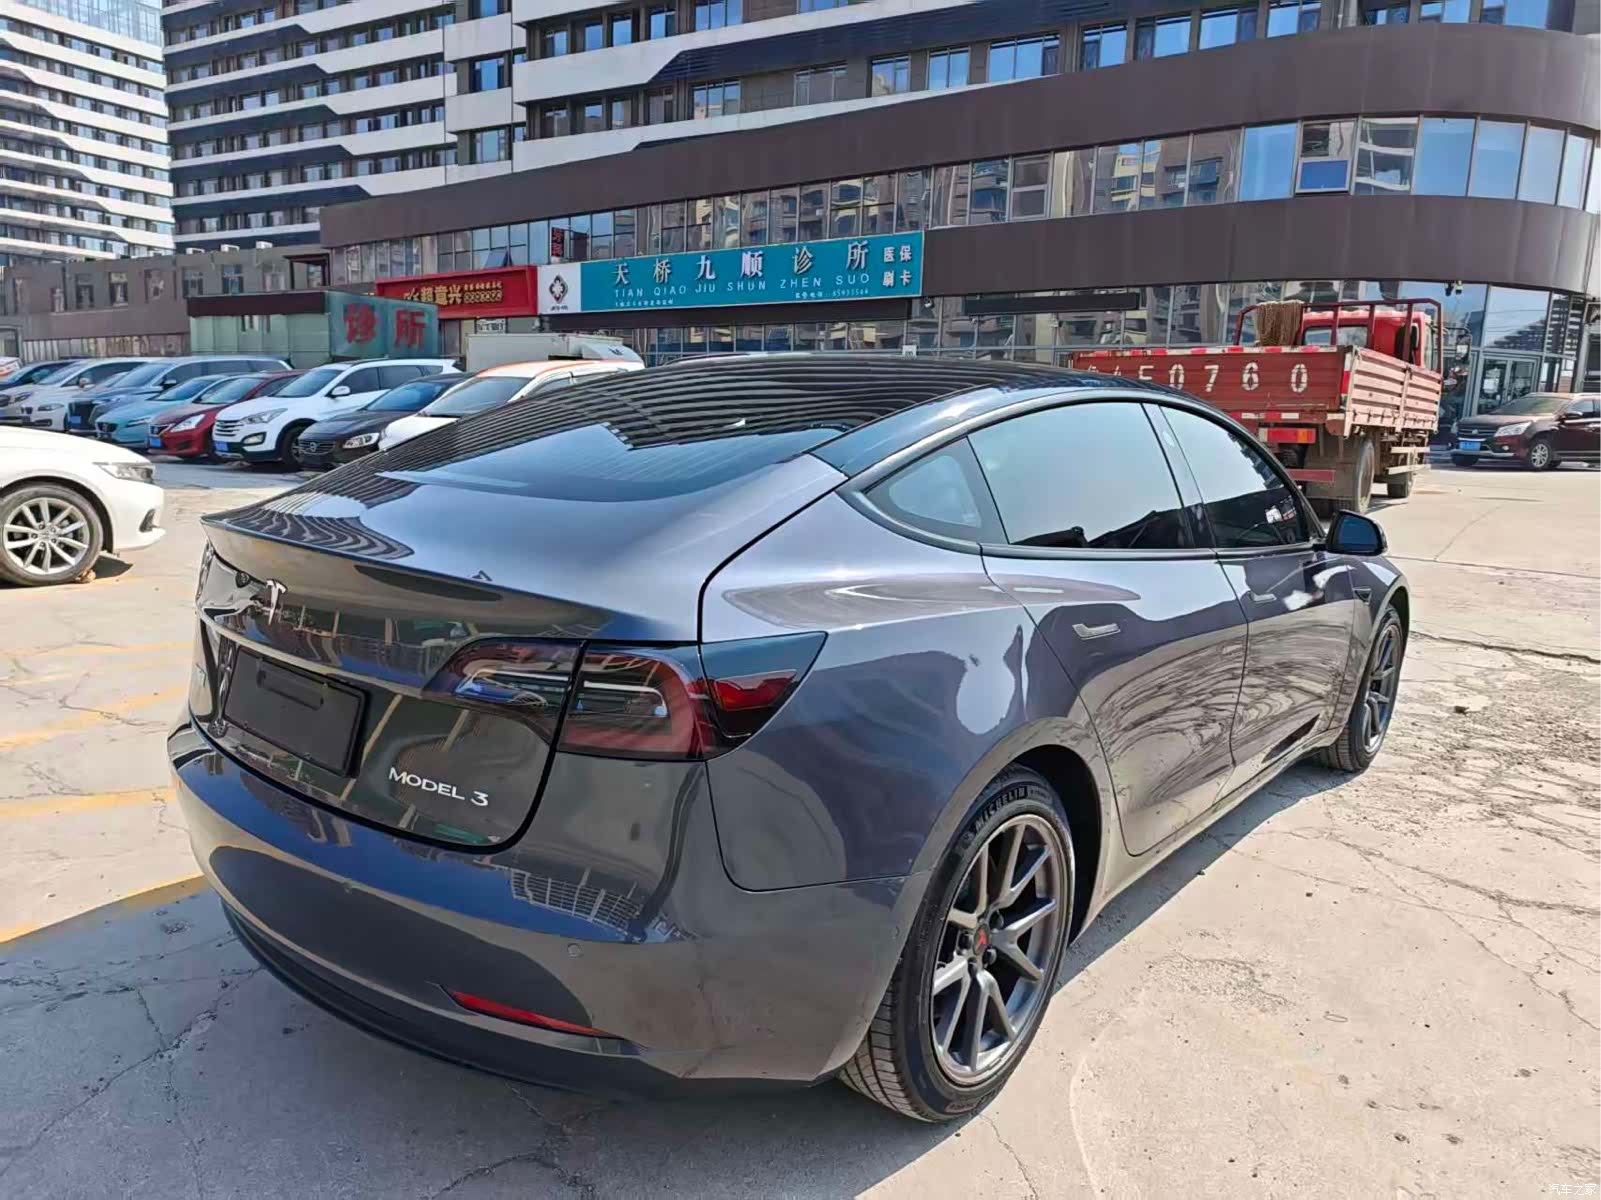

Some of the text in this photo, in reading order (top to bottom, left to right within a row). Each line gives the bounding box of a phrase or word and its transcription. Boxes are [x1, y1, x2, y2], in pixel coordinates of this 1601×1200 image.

[612, 240, 869, 285] 天桥九顺诊所
[883, 245, 912, 263] 医保
[615, 272, 870, 298] TIAN QIAO JIU SHUN ZHEN SUO
[882, 270, 912, 287] 刷卡
[343, 303, 426, 347] 诊所
[1087, 362, 1308, 393] 50760
[388, 767, 489, 807] MODEL 3
[975, 785, 1028, 835] MICHELIN
